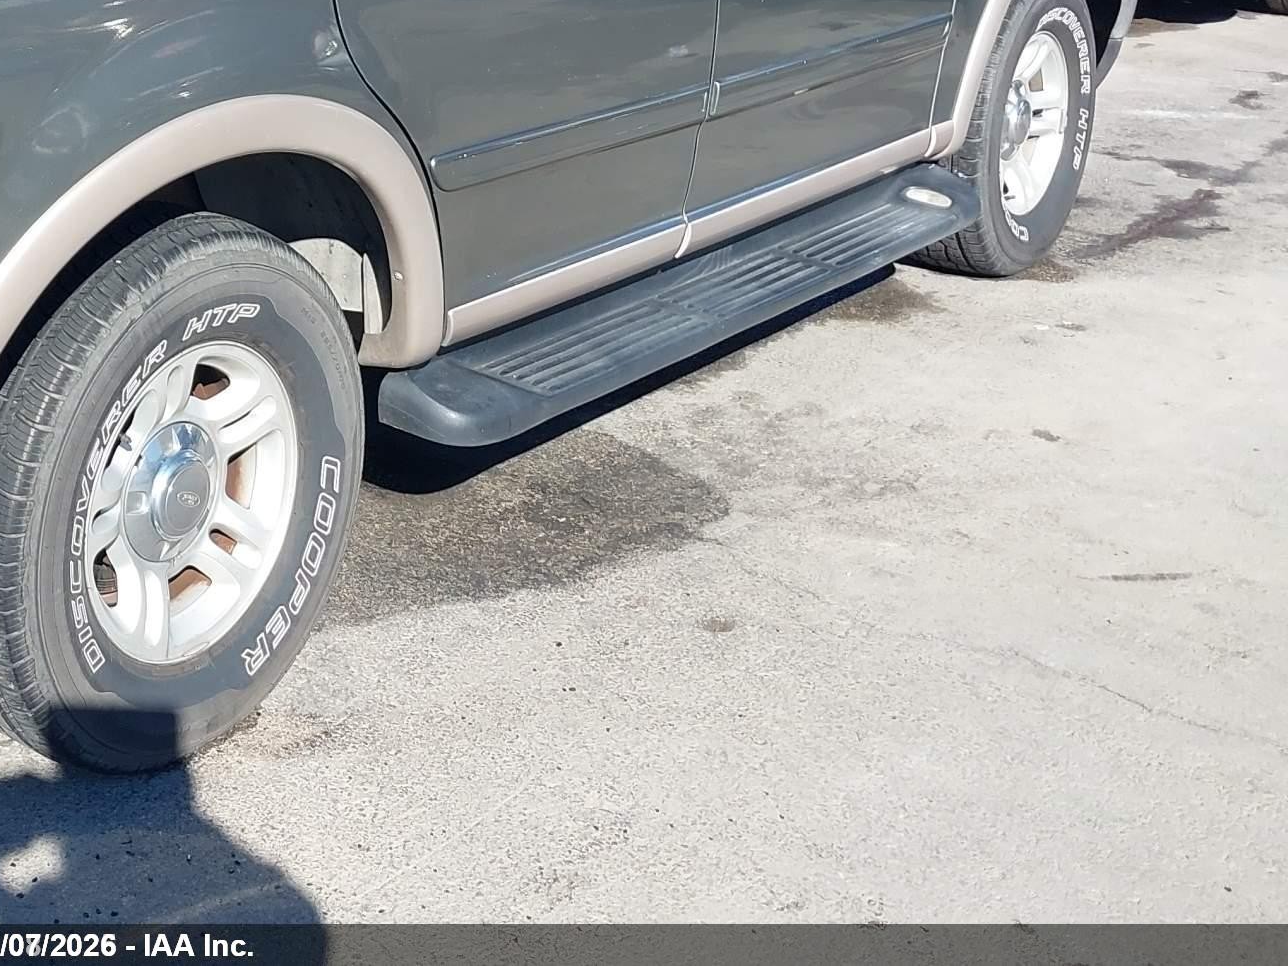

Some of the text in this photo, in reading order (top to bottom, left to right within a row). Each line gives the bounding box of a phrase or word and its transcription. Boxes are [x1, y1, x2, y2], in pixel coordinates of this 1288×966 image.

[1073, 108, 1089, 171] HTP
[68, 303, 261, 675] DISCOVERER HTP
[241, 455, 342, 676] COOPER
